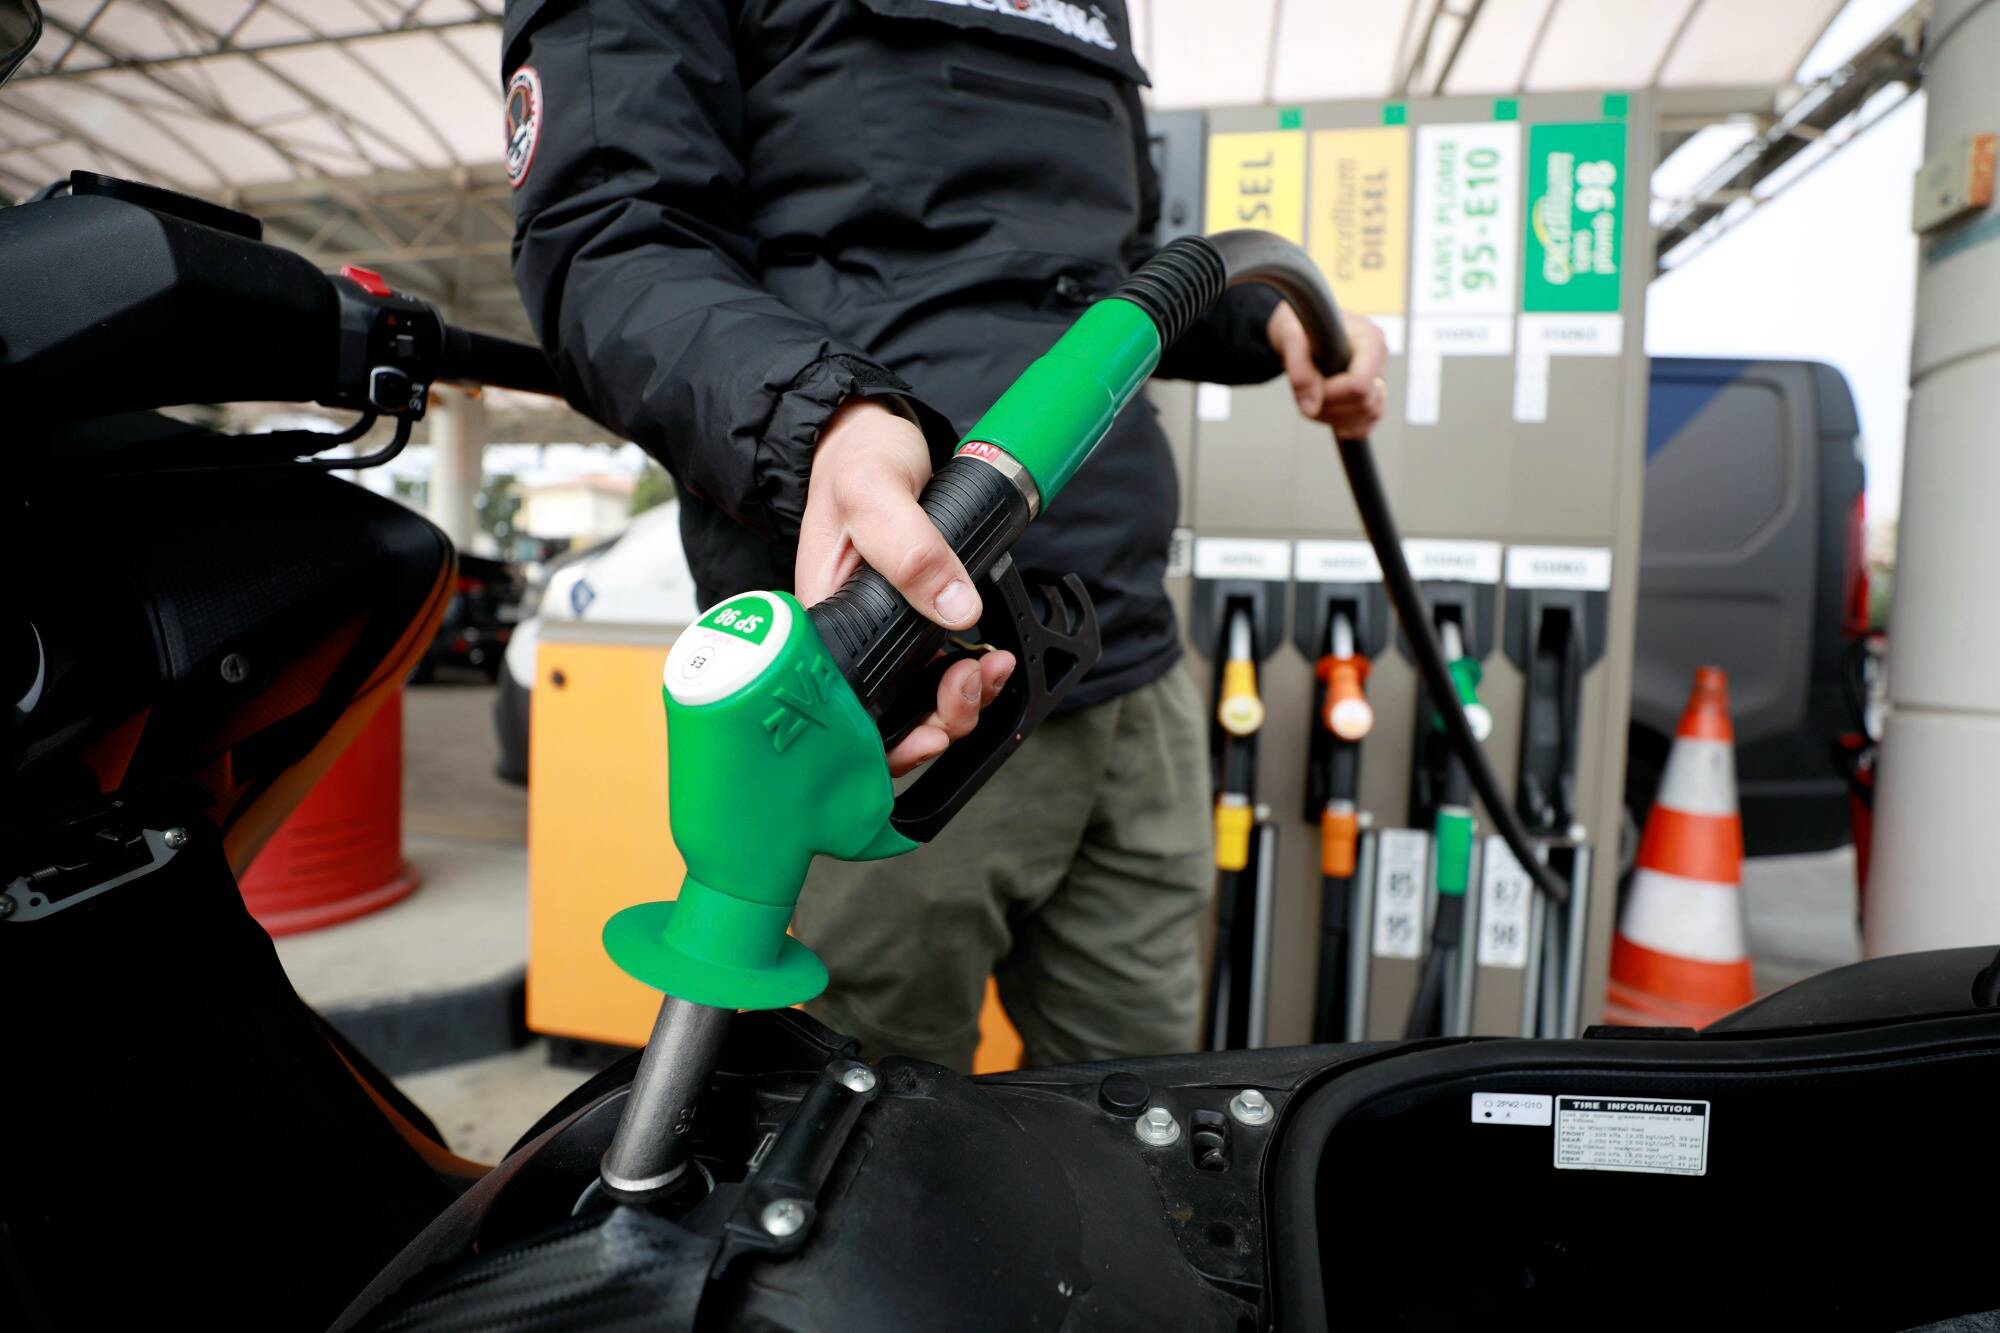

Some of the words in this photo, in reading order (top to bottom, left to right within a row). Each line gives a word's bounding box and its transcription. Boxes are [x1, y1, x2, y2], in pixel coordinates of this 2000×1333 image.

[1239, 149, 1274, 222] SEL
[1574, 159, 1617, 213] 98
[1360, 168, 1388, 269] DIESEL
[1461, 148, 1499, 290] 95-E10
[713, 608, 741, 627] 98
[737, 614, 764, 633] SP
[1572, 1101, 1600, 1110] TIRE
[1607, 1102, 1692, 1113] INFORMATION
